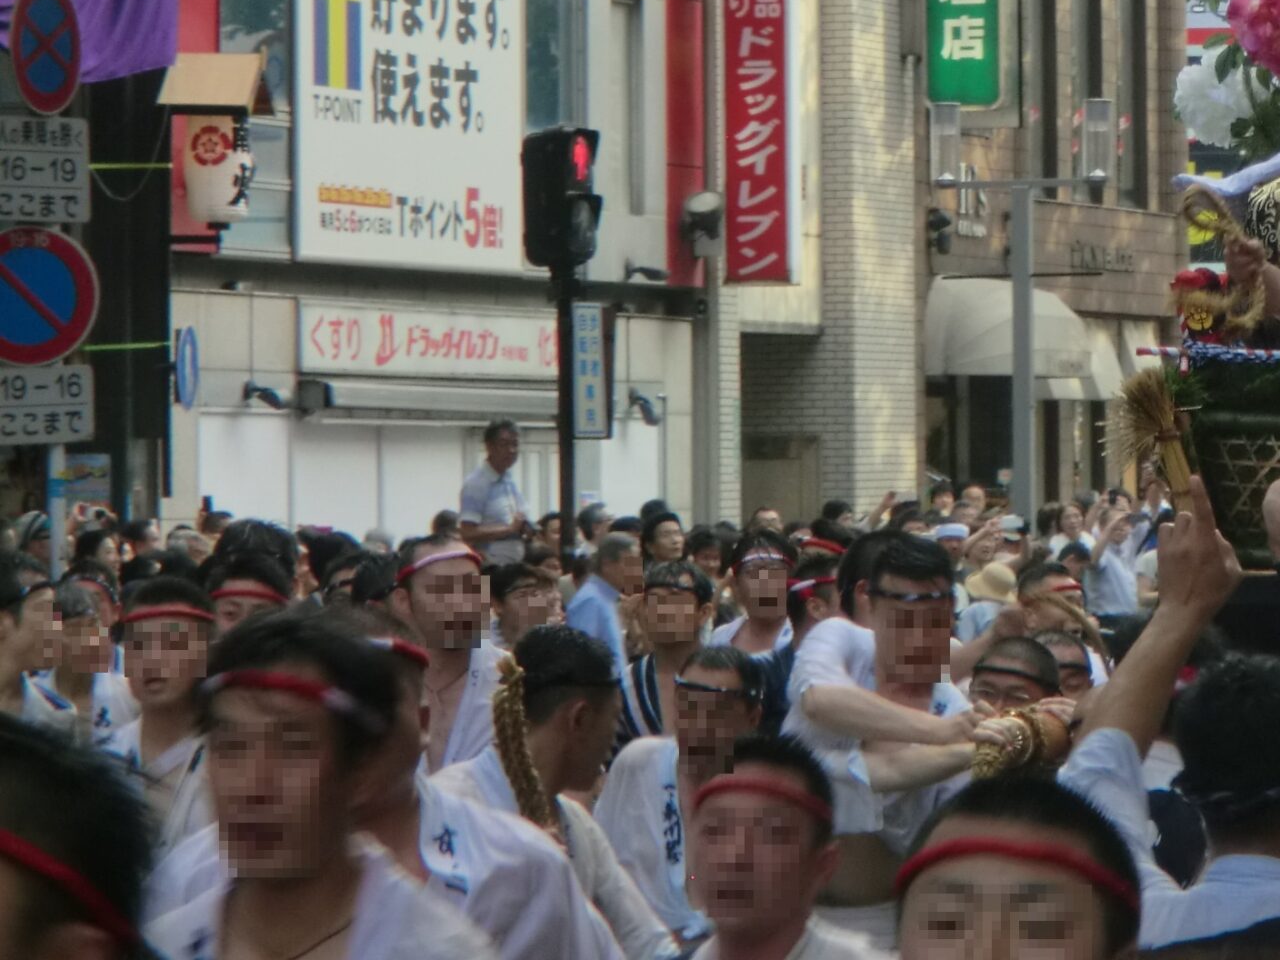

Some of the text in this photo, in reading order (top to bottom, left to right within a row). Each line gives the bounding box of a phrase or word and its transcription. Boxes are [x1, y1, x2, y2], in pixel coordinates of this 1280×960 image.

[313, 93, 362, 124] T-POINT
[371, 49, 484, 133] 使えます。
[735, 27, 780, 275] ドラッグイレブン
[311, 313, 362, 361] くすり
[406, 324, 499, 361] ドラッグイレブン
[1, 411, 83, 437] ここまで
